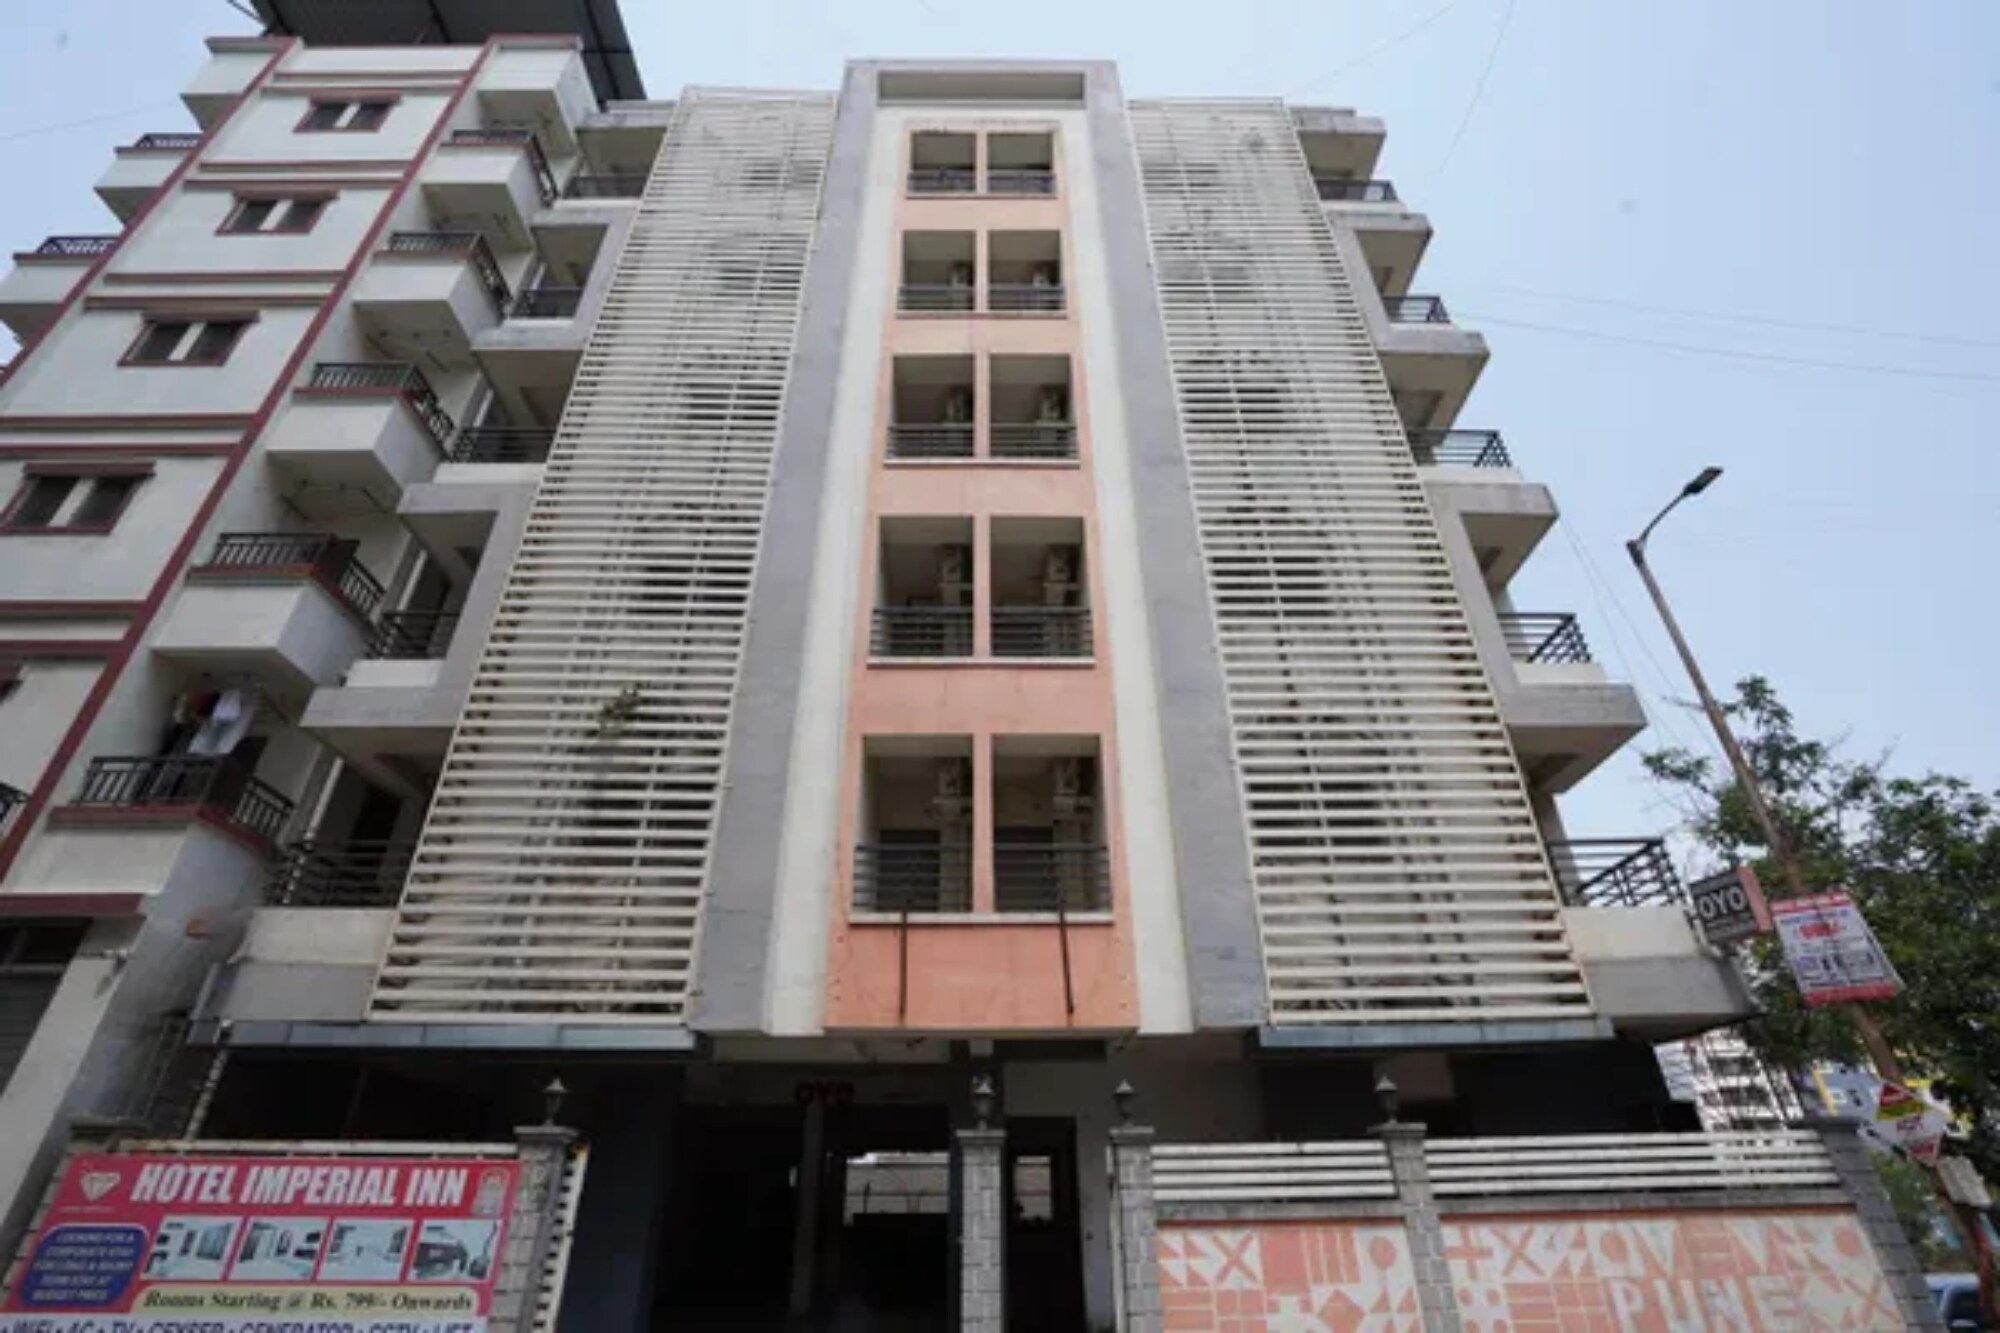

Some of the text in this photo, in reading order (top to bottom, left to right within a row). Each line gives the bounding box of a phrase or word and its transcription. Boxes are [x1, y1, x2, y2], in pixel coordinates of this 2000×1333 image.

[1699, 886, 1747, 920] OYO
[129, 1163, 469, 1207] HOTEL IMPERIAL INN
[211, 1291, 281, 1312] Starting
[392, 1292, 471, 1310] Onwards
[1607, 1276, 1802, 1333] PUNE
